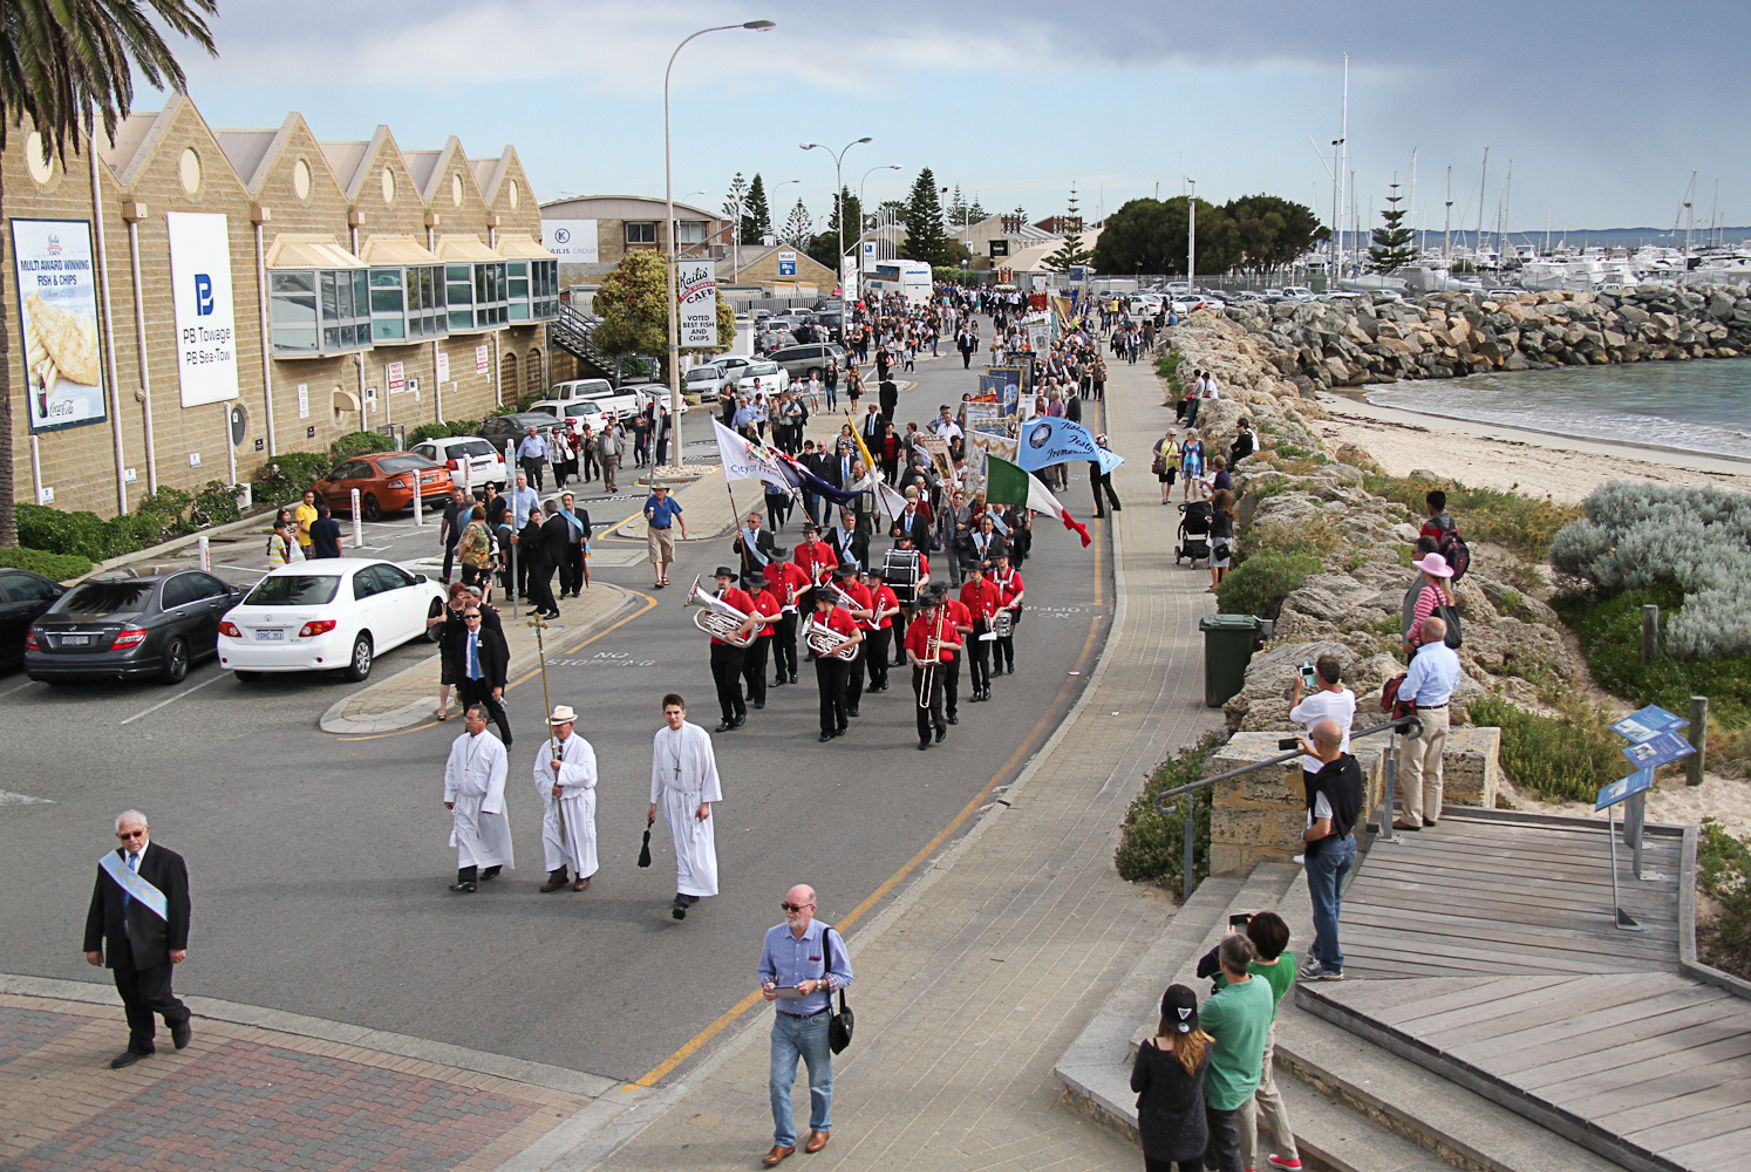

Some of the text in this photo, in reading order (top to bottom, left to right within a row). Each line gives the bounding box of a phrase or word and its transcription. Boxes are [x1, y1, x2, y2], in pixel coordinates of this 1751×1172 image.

[20, 259, 89, 271] MULTI AWARD WINNING
[37, 275, 52, 286] FISH
[59, 273, 77, 286] CHIPS
[686, 288, 715, 304] CAFE
[183, 326, 231, 344] PB Towage
[186, 347, 231, 365] PB Sea-Tow
[730, 464, 749, 474] City
[594, 651, 629, 659] NO
